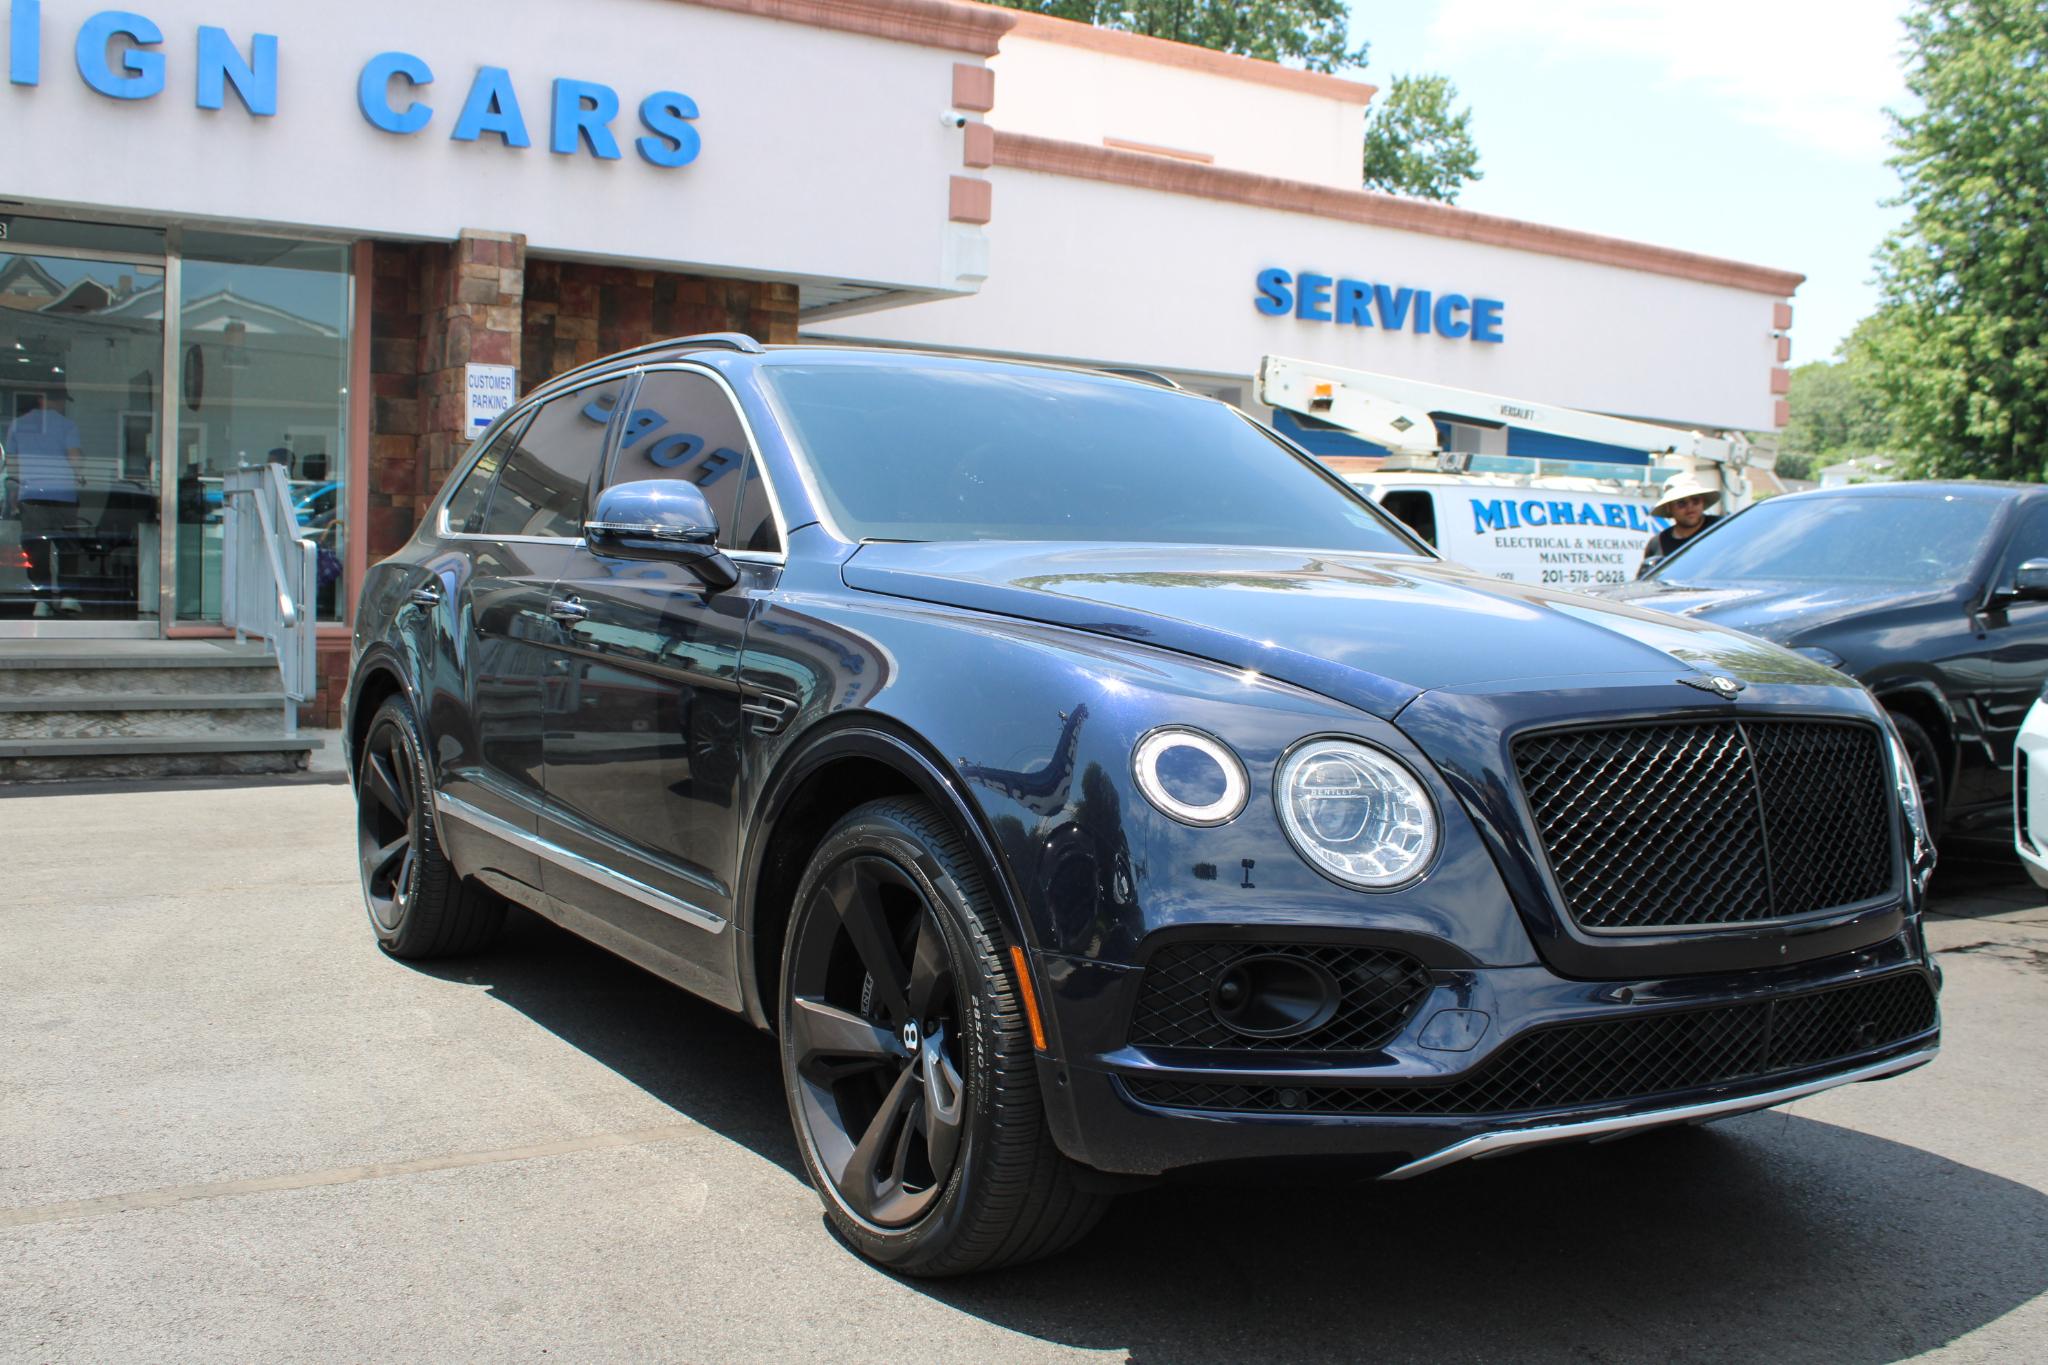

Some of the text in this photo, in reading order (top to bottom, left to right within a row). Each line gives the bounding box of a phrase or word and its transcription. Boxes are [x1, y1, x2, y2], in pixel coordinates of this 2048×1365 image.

[10, 0, 702, 168] IGN CARS
[1254, 267, 1504, 343] SERVICE
[468, 374, 512, 390] CUSTOMER
[472, 394, 508, 410] PARKING
[1495, 537, 1571, 549] ELECTRICAL
[1574, 538, 1583, 549] &
[1539, 553, 1624, 565] MAINTENANCE
[1542, 570, 1625, 583] 201-578-0628
